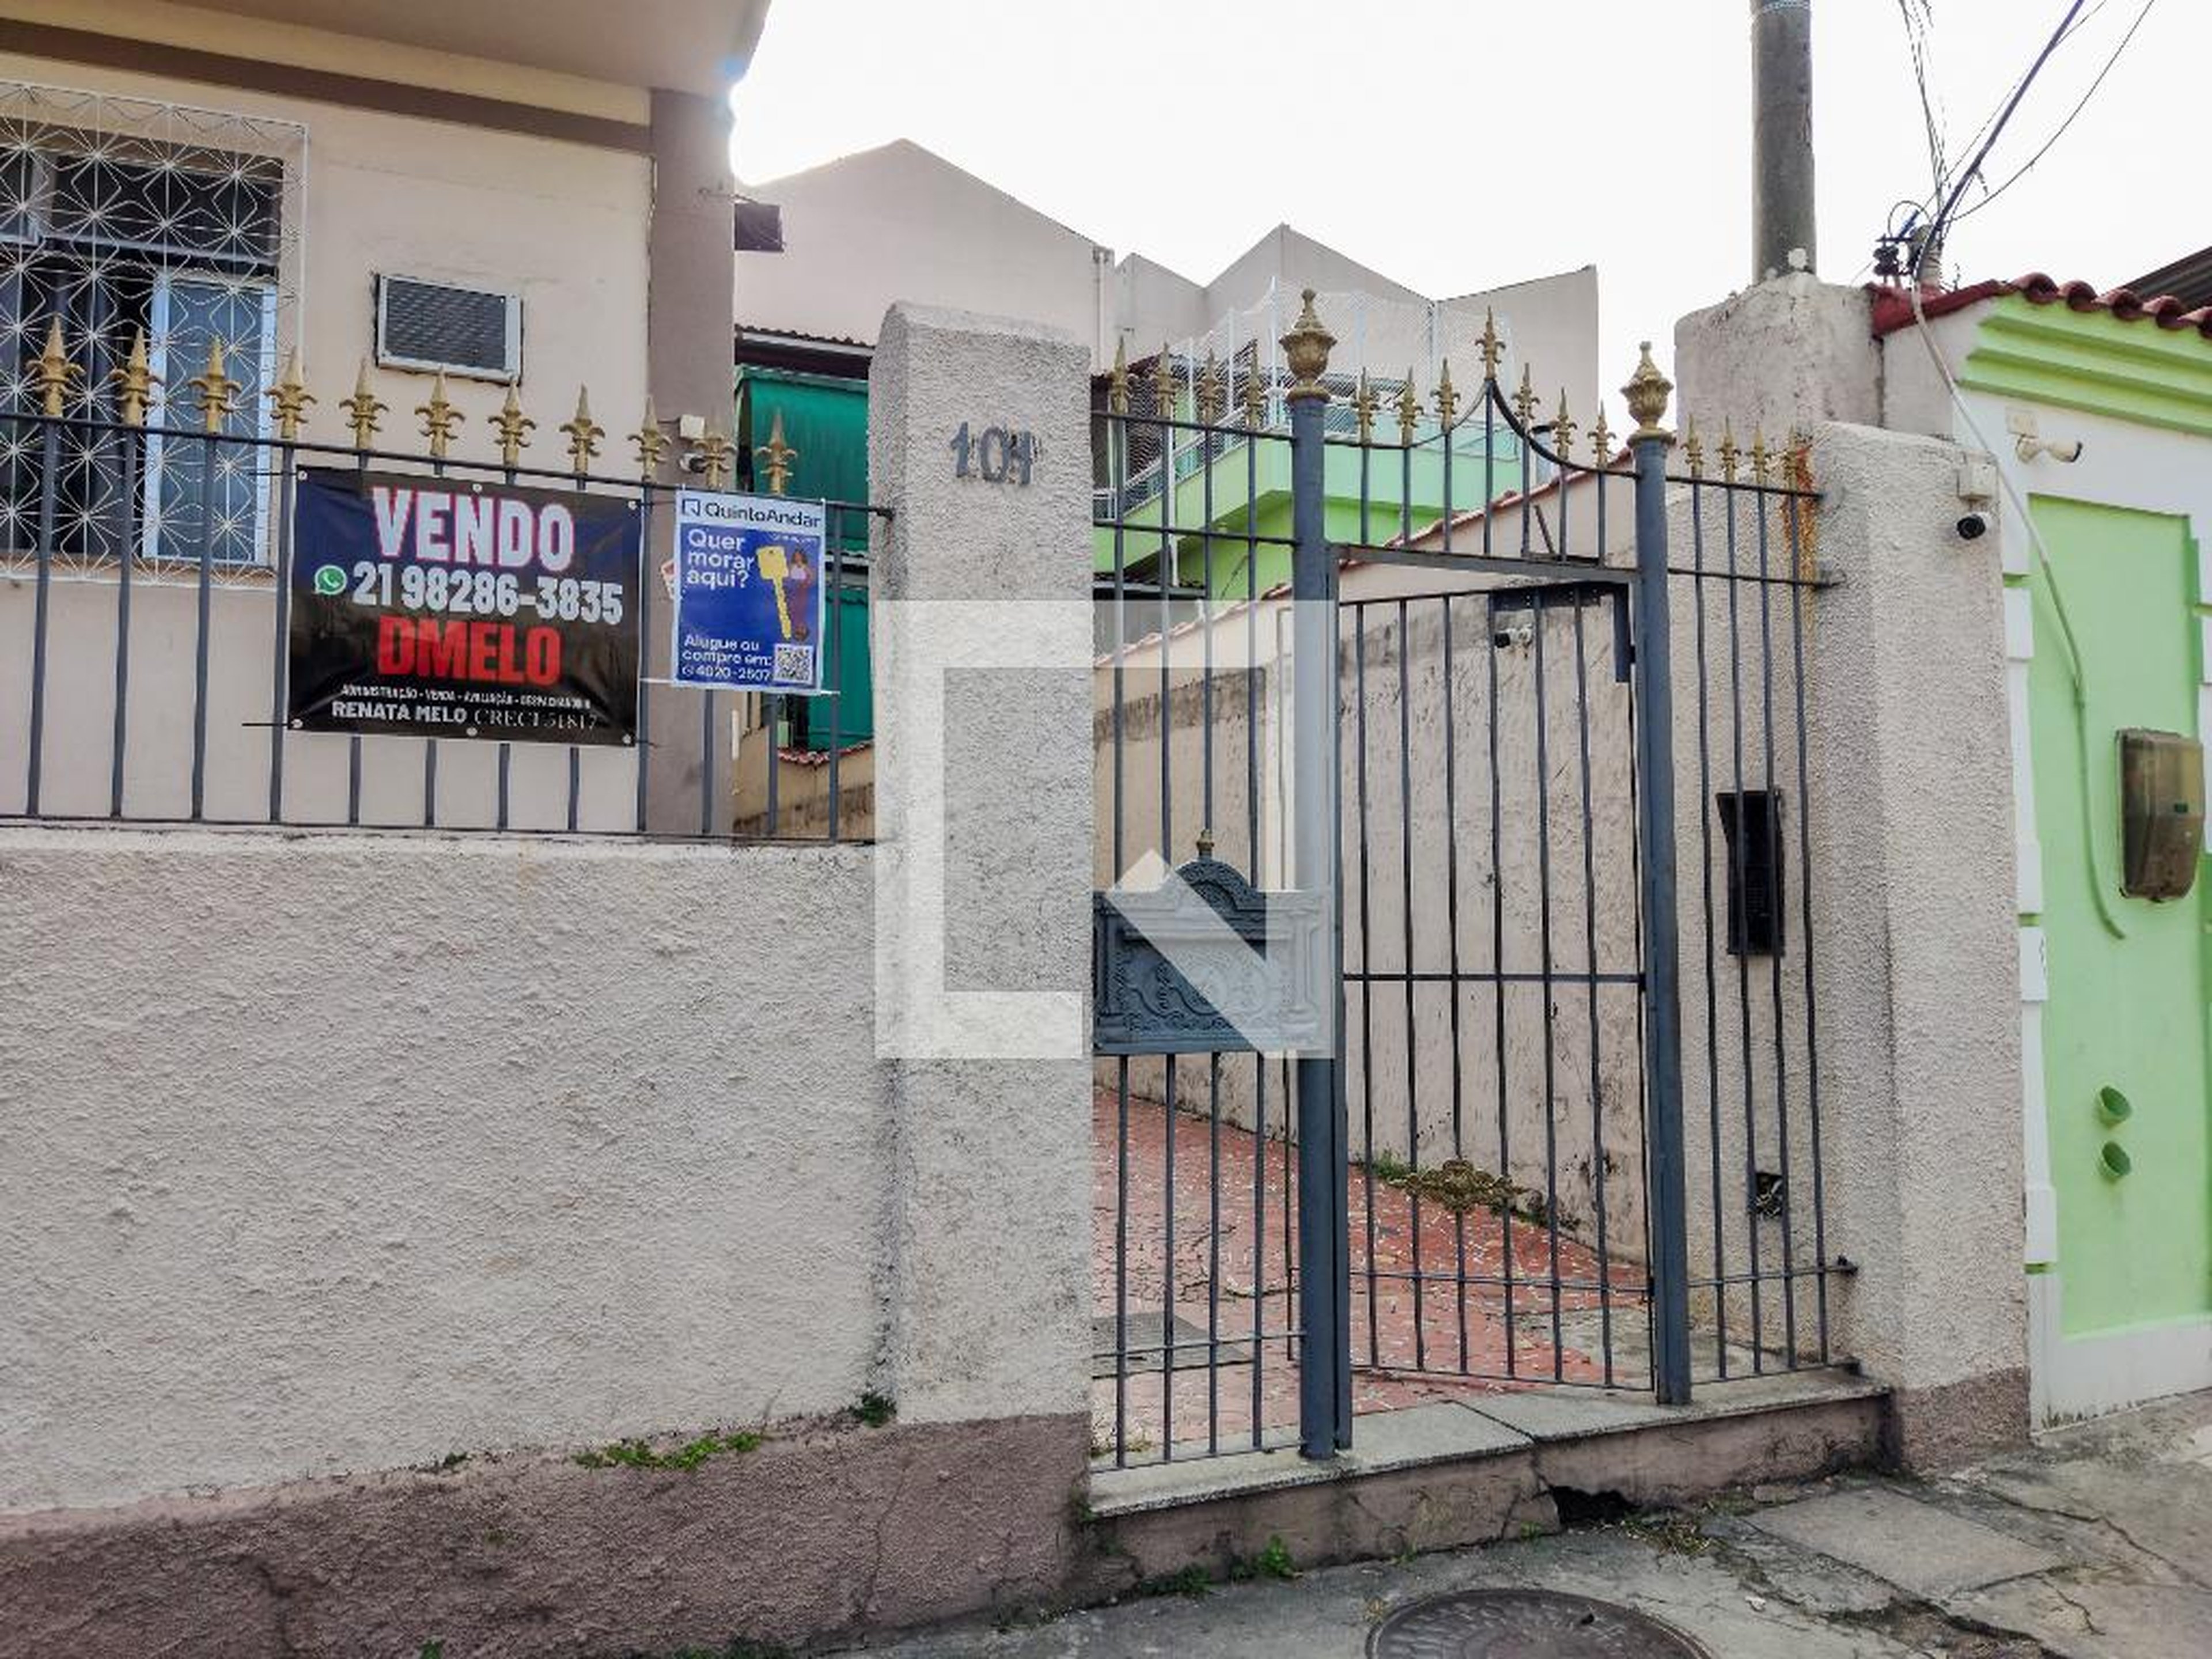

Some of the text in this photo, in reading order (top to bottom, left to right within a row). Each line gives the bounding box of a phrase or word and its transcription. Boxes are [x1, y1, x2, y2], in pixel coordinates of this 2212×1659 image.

[705, 502, 821, 528] QuintoAndar
[373, 486, 574, 571] VENDO
[688, 528, 746, 551] Quer
[687, 550, 755, 570] morar
[687, 569, 749, 590] aqui?
[352, 560, 624, 625] 21 98286-3835
[377, 615, 563, 686] DMELO
[684, 634, 760, 652] Alugue ou
[681, 650, 742, 664] compre
[331, 700, 411, 721] RENATA
[415, 705, 468, 724] MELO
